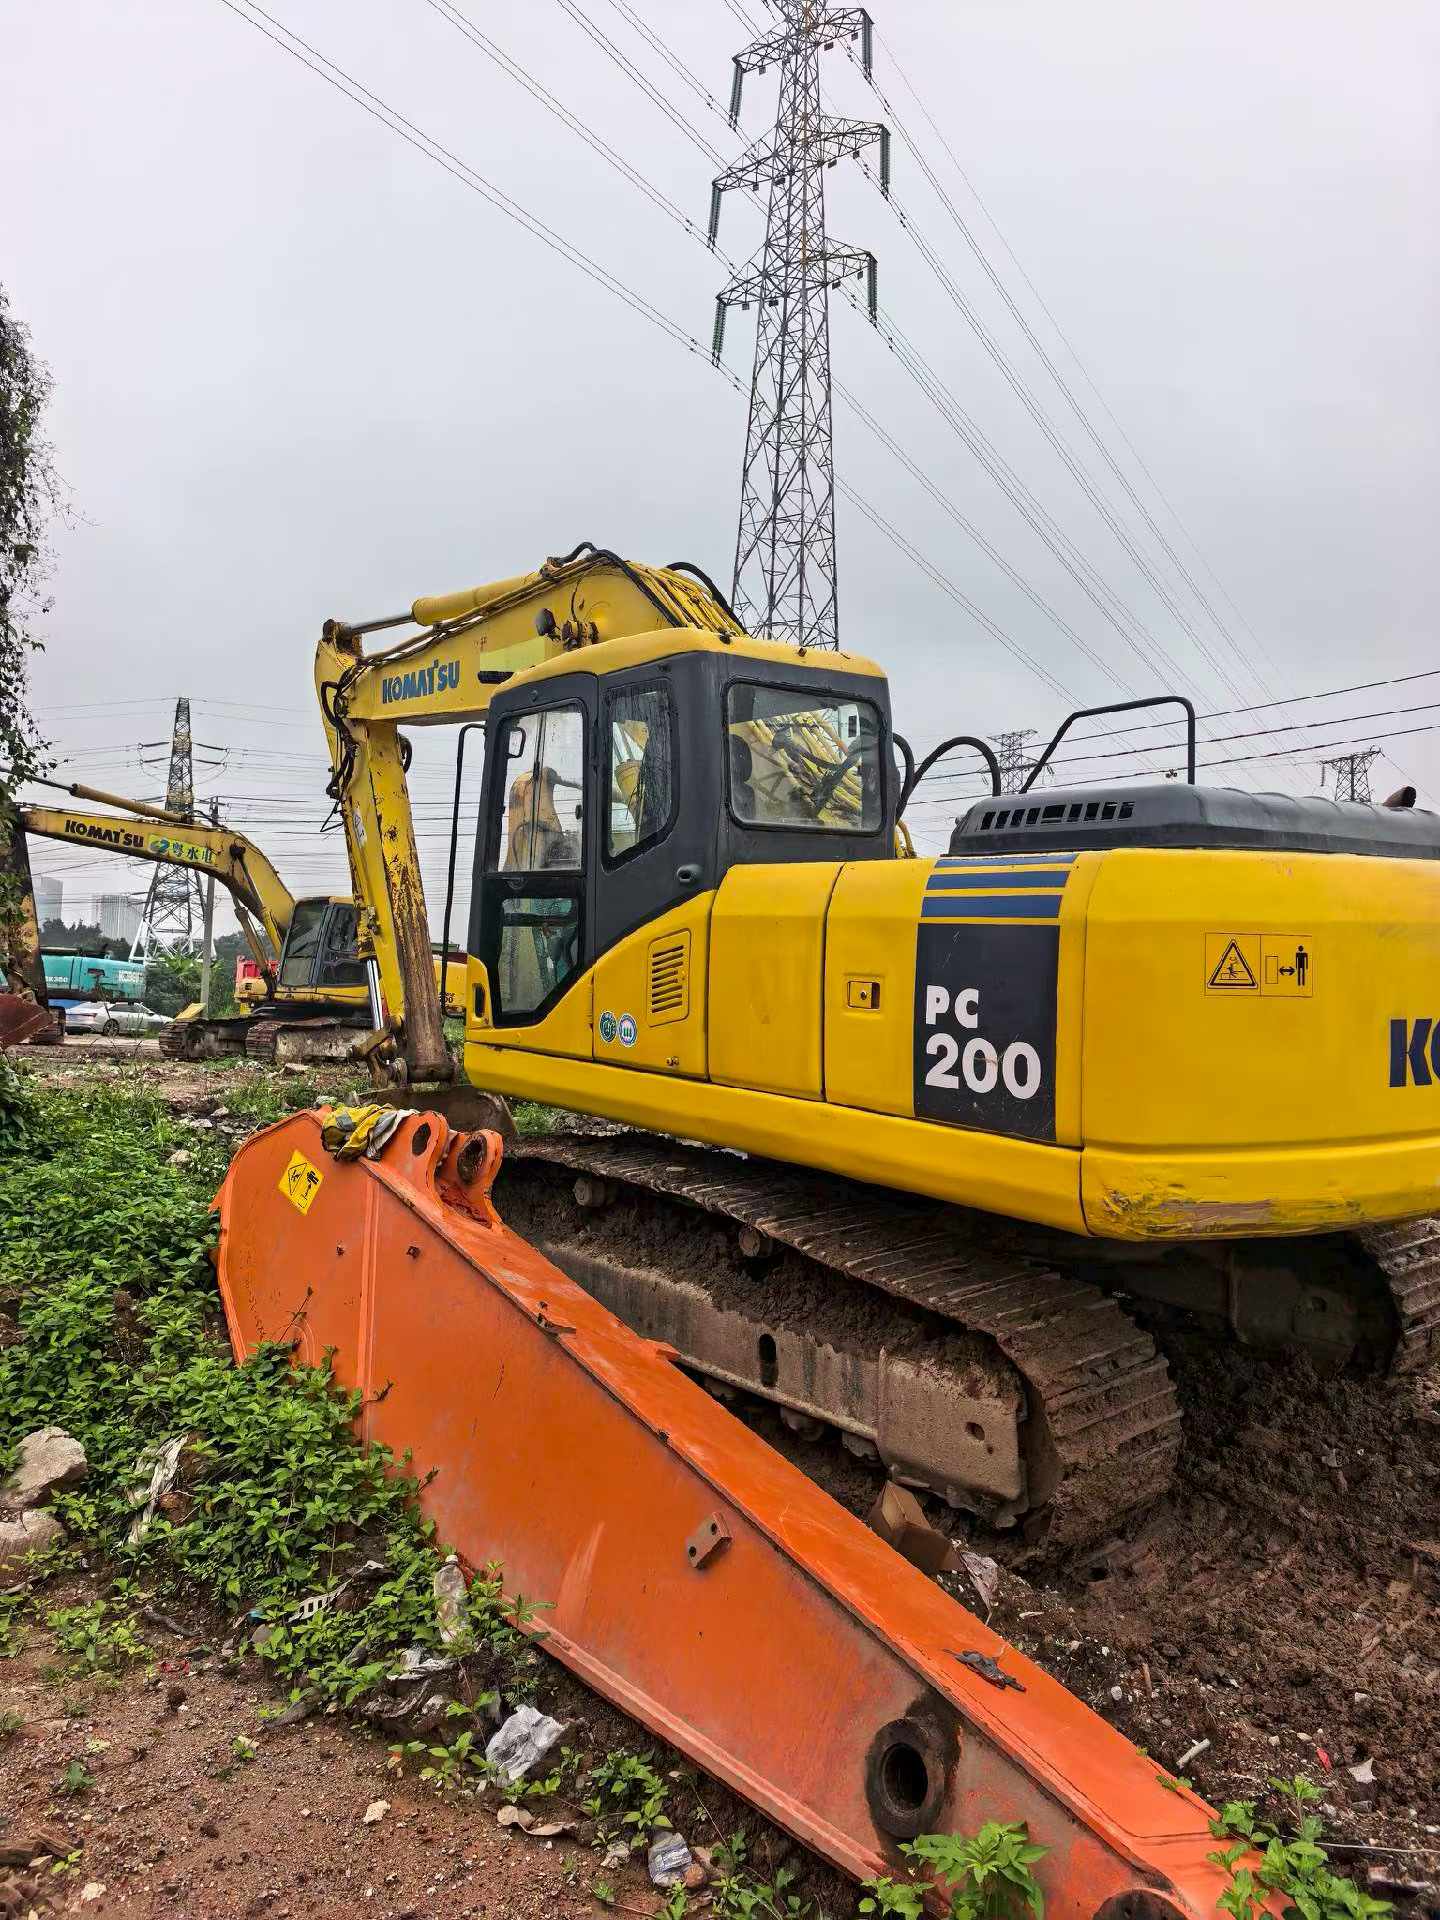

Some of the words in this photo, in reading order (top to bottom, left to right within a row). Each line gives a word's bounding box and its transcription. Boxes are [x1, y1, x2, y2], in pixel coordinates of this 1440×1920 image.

[382, 659, 460, 704] KOMATSU
[65, 819, 145, 848] KOMATSU
[925, 984, 980, 1029] PC
[925, 1032, 1042, 1100] 200
